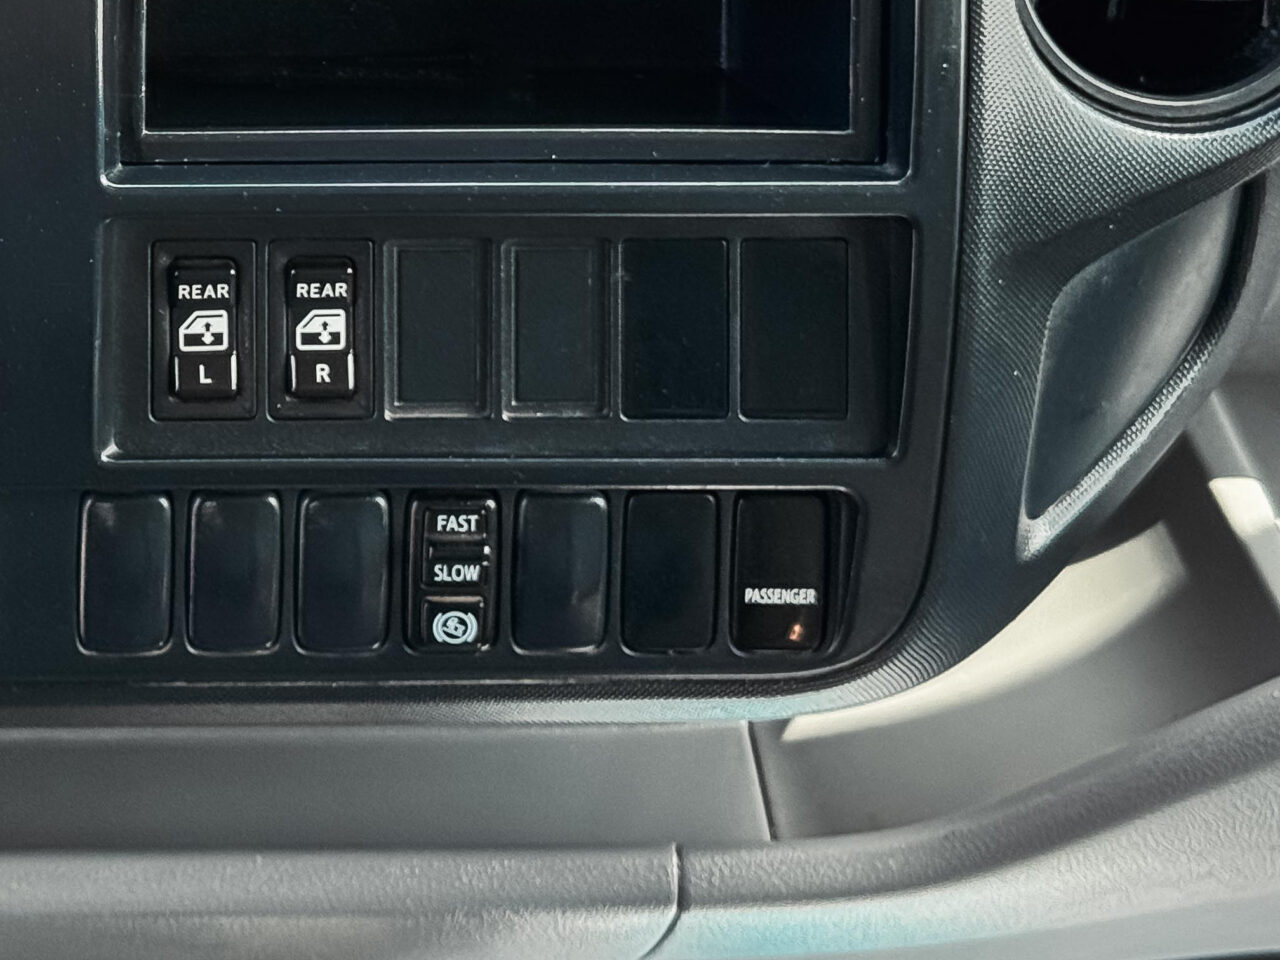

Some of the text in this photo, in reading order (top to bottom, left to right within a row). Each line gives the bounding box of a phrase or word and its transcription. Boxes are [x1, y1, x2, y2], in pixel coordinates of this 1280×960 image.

[178, 284, 229, 299] REAR
[296, 282, 348, 298] REAR
[199, 364, 212, 384] L
[315, 363, 331, 383] R
[436, 515, 479, 532] FAST
[434, 564, 480, 582] SLOW
[744, 588, 817, 605] PASSENGER
